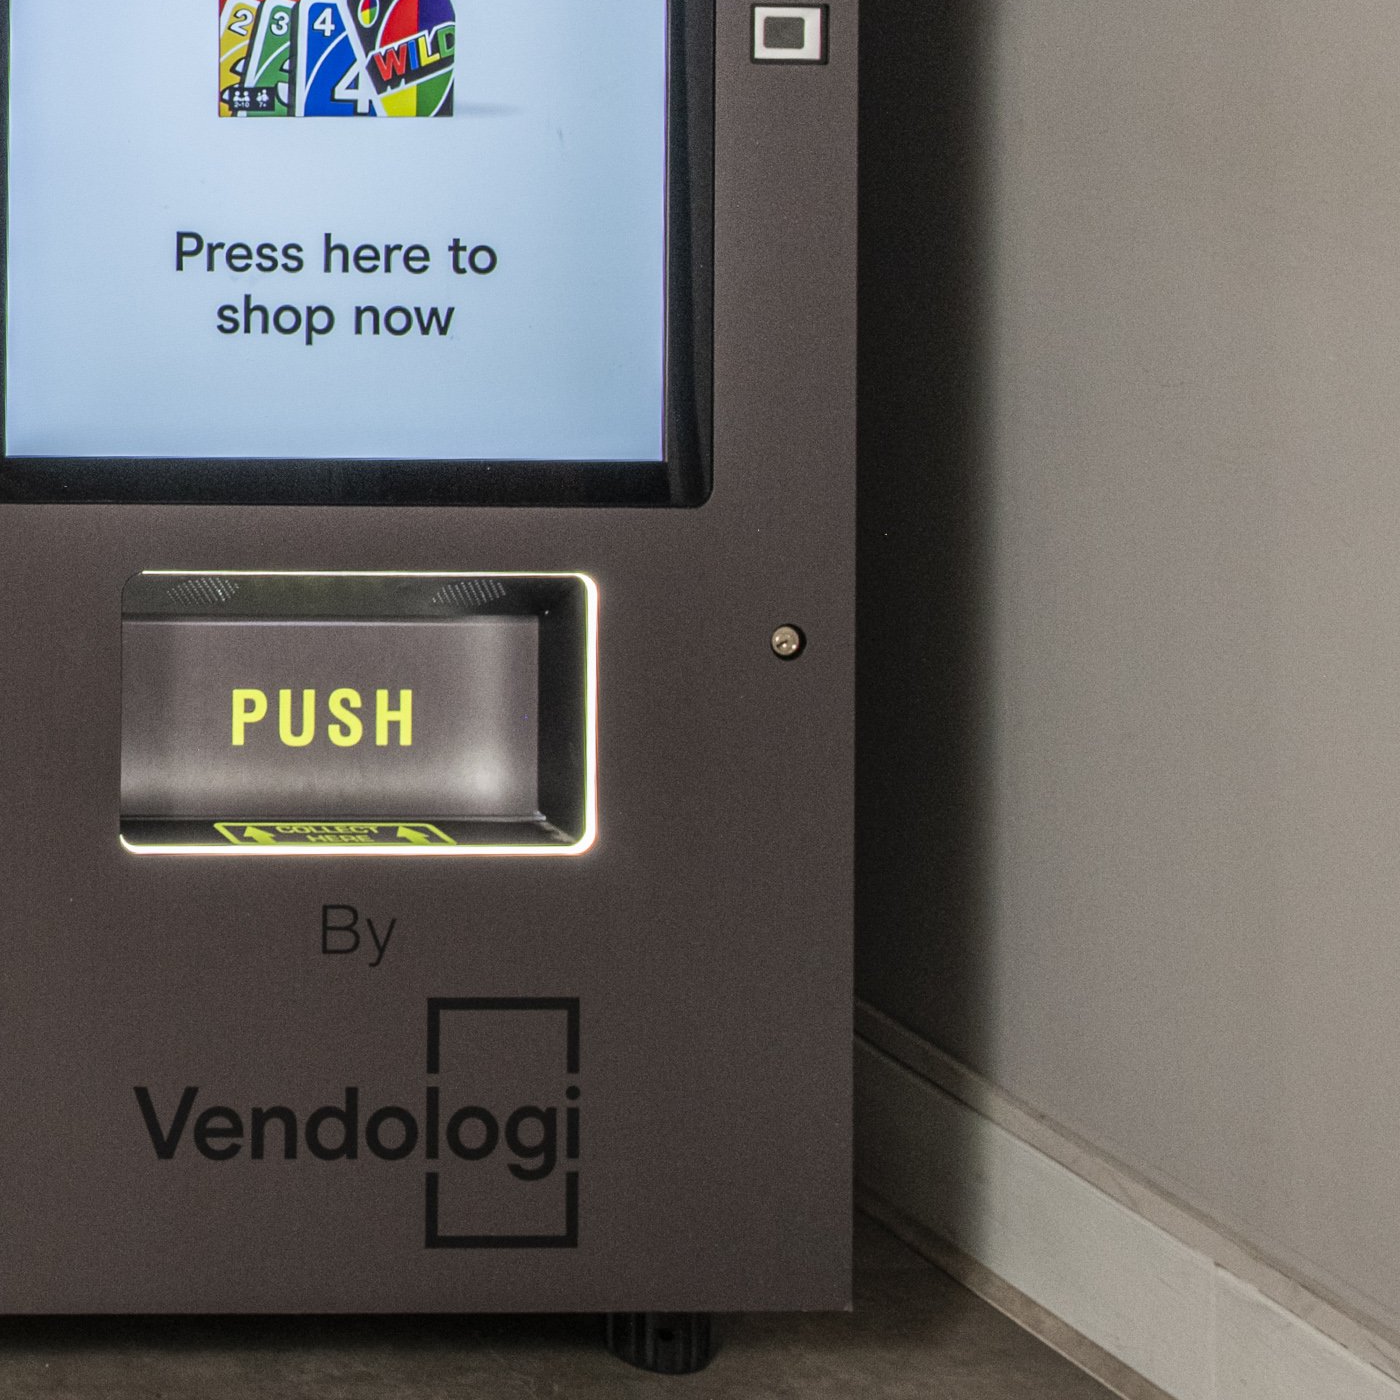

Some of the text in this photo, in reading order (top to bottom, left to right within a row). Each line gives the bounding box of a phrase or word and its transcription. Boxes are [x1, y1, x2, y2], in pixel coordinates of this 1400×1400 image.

[229, 8, 253, 35] 2
[270, 11, 289, 35] 3
[313, 8, 335, 37] 4
[373, 23, 456, 83] WILD
[175, 231, 498, 274] Press here to
[216, 293, 455, 346] shop now
[231, 688, 413, 747] PUSH
[275, 825, 380, 834] COLLECT
[306, 834, 376, 843] HERE
[321, 904, 397, 966] By
[133, 1085, 581, 1182] Vendologi
